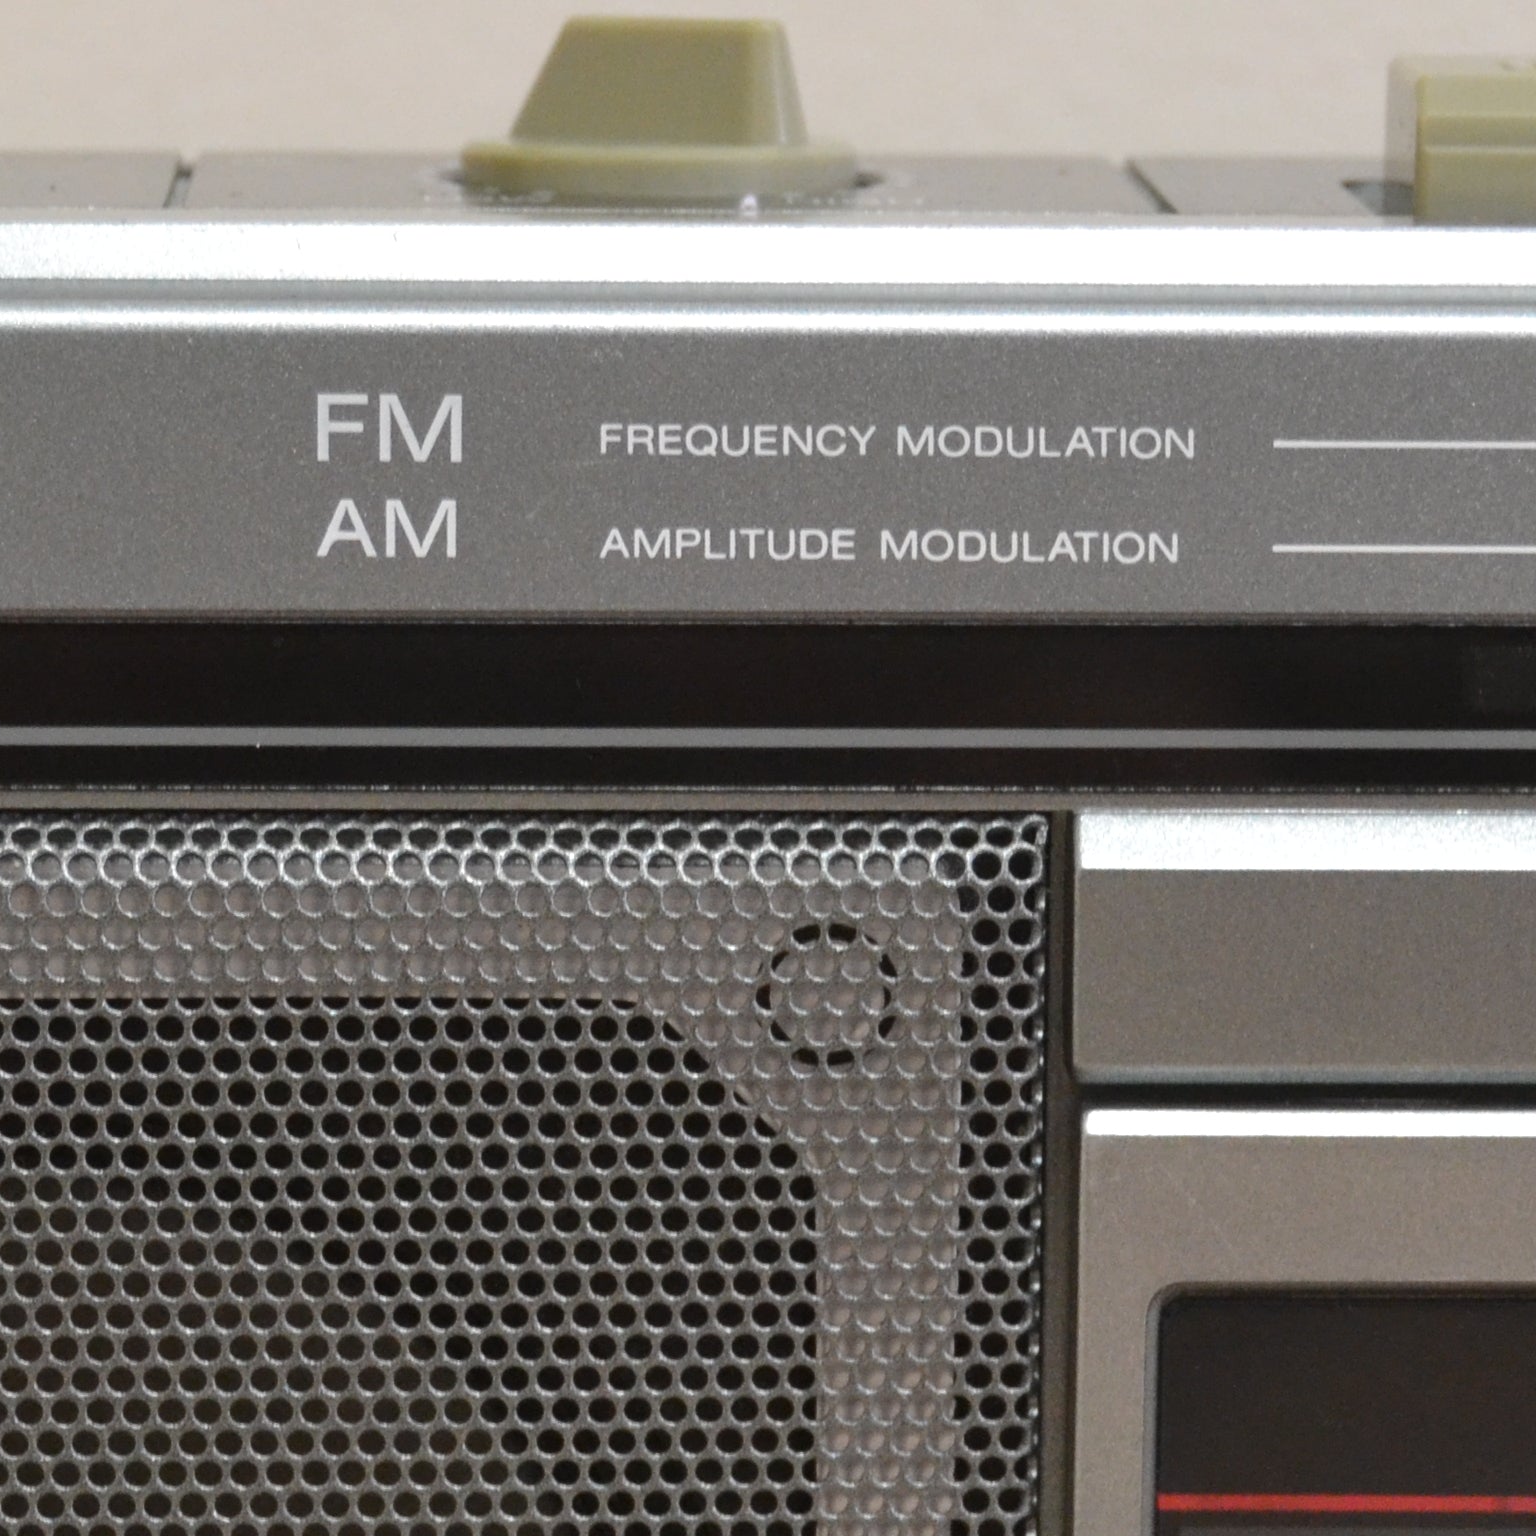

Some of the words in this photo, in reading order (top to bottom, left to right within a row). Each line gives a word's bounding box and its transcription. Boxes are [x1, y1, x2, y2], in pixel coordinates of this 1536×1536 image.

[316, 393, 463, 463] FM
[600, 423, 876, 457] FREQUENCY
[897, 425, 1195, 460] MODULATION
[316, 498, 457, 558] AM
[599, 527, 855, 561] AMPLITUDE
[880, 529, 1179, 564] MODULATION
